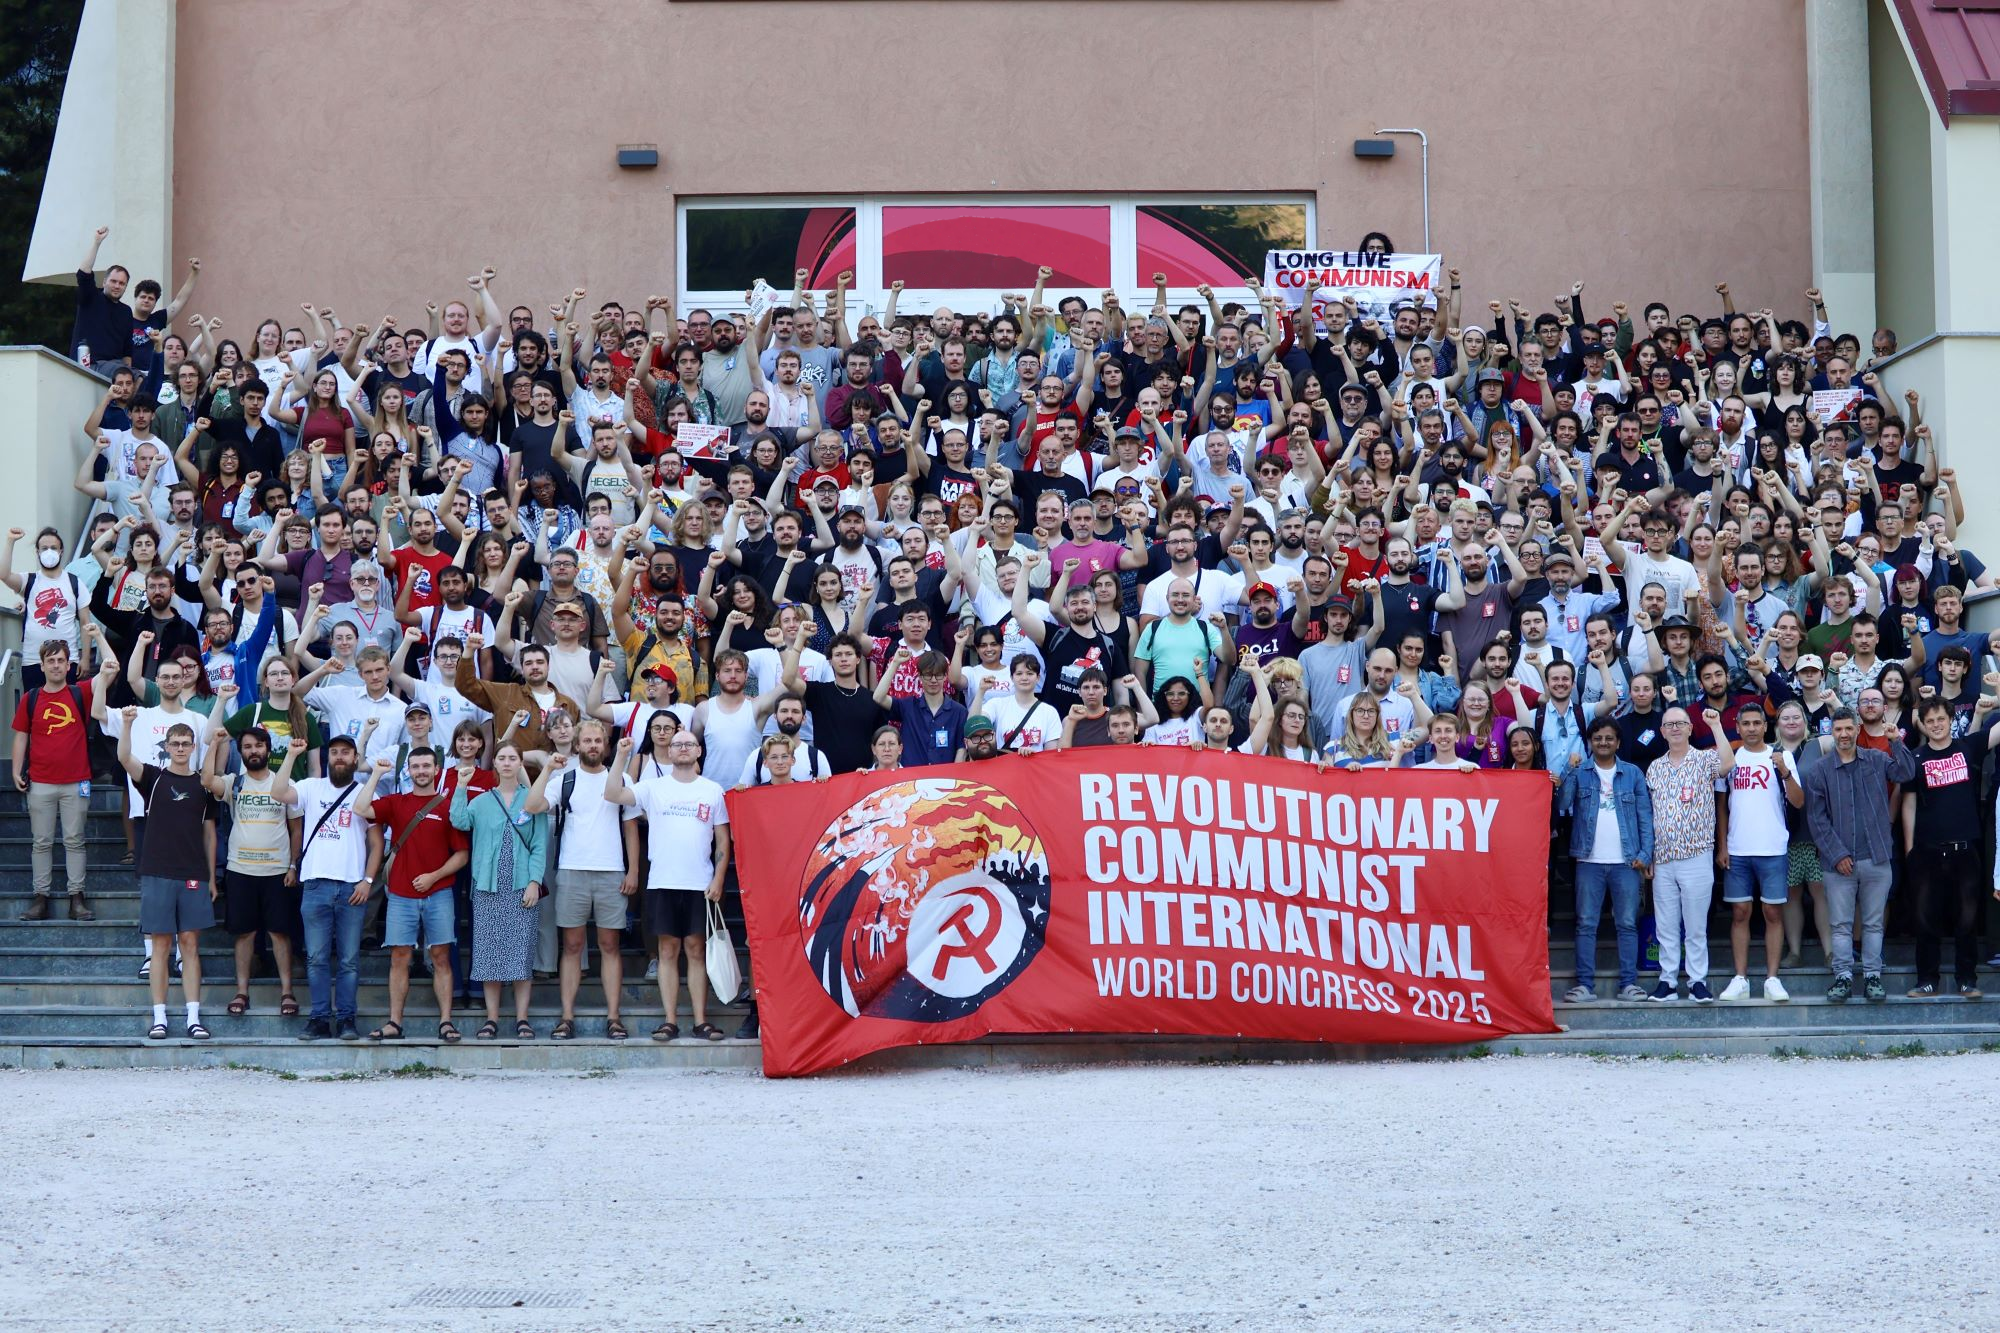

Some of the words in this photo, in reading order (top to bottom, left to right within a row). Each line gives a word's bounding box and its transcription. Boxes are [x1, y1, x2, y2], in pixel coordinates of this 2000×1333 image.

[1275, 252, 1334, 270] LONG
[1343, 252, 1392, 269] LIVE
[1275, 269, 1430, 290] COMMUNISM
[1925, 753, 1967, 773] SOCIALIST
[1926, 767, 1969, 787] REVOLUTION
[1080, 773, 1500, 853] REVOLUTIONARY
[1084, 826, 1426, 915] COMMUNIST
[1088, 891, 1486, 982] INTERNATIONAL
[1092, 957, 1218, 1001] WORLD
[1230, 962, 1401, 1015] CONGRESS
[1407, 986, 1492, 1026] 2025
